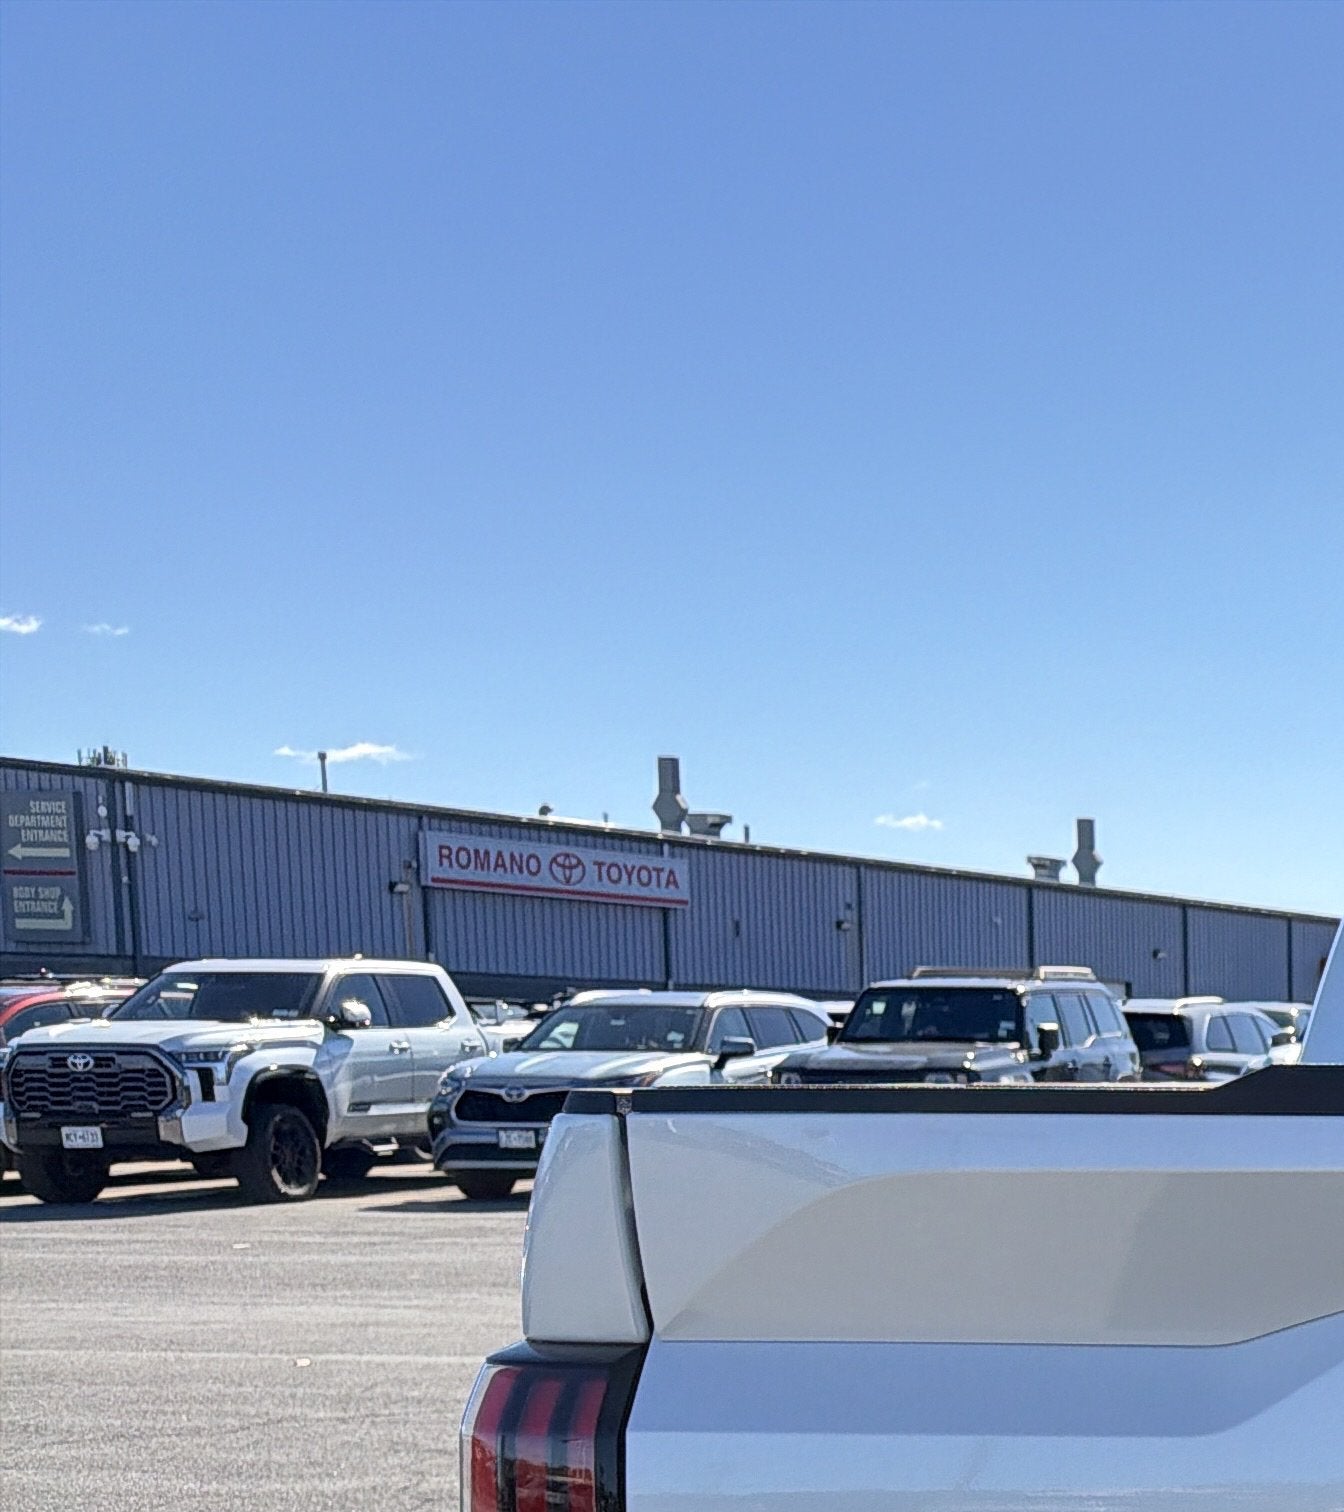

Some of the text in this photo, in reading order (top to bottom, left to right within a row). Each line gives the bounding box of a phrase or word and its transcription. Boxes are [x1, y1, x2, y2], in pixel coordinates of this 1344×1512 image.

[29, 800, 67, 813] SERVICE
[8, 815, 67, 828] DEPARTMENT
[21, 829, 69, 842] ENTRANCE
[438, 844, 680, 889] ROMANO TOYOTA
[14, 900, 59, 914] ENTRANCE
